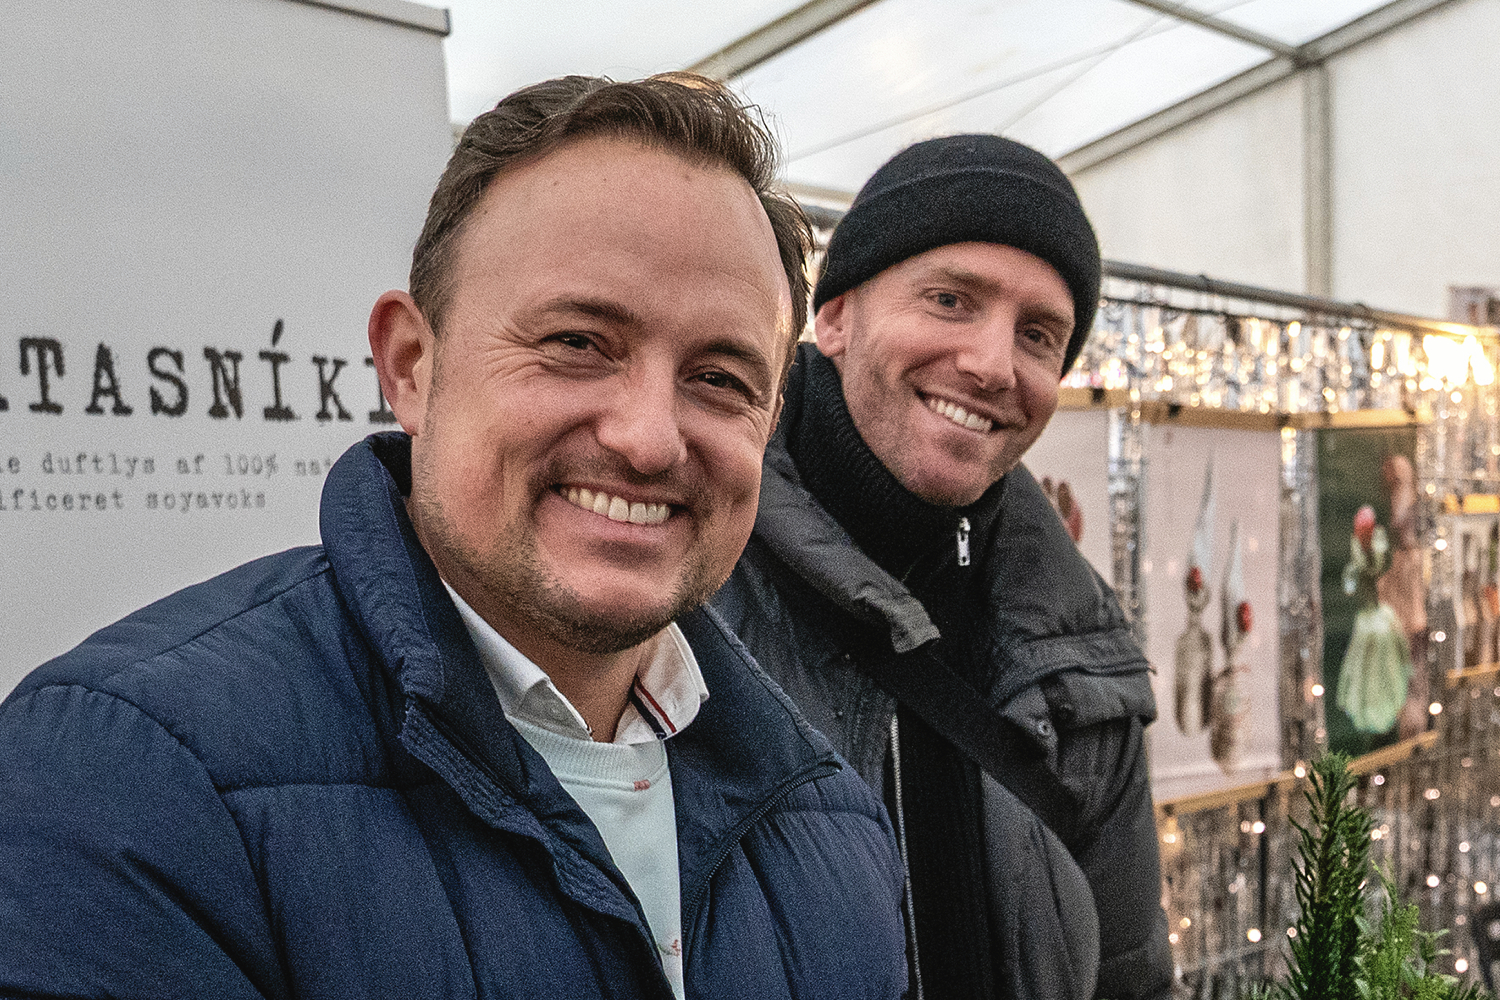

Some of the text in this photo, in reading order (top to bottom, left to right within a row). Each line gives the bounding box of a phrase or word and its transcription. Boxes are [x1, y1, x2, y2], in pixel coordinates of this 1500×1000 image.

[0, 319, 398, 425] TASNÍK
[41, 453, 156, 480] duftlys
[176, 455, 205, 475] af
[146, 488, 267, 514] soyavoks
